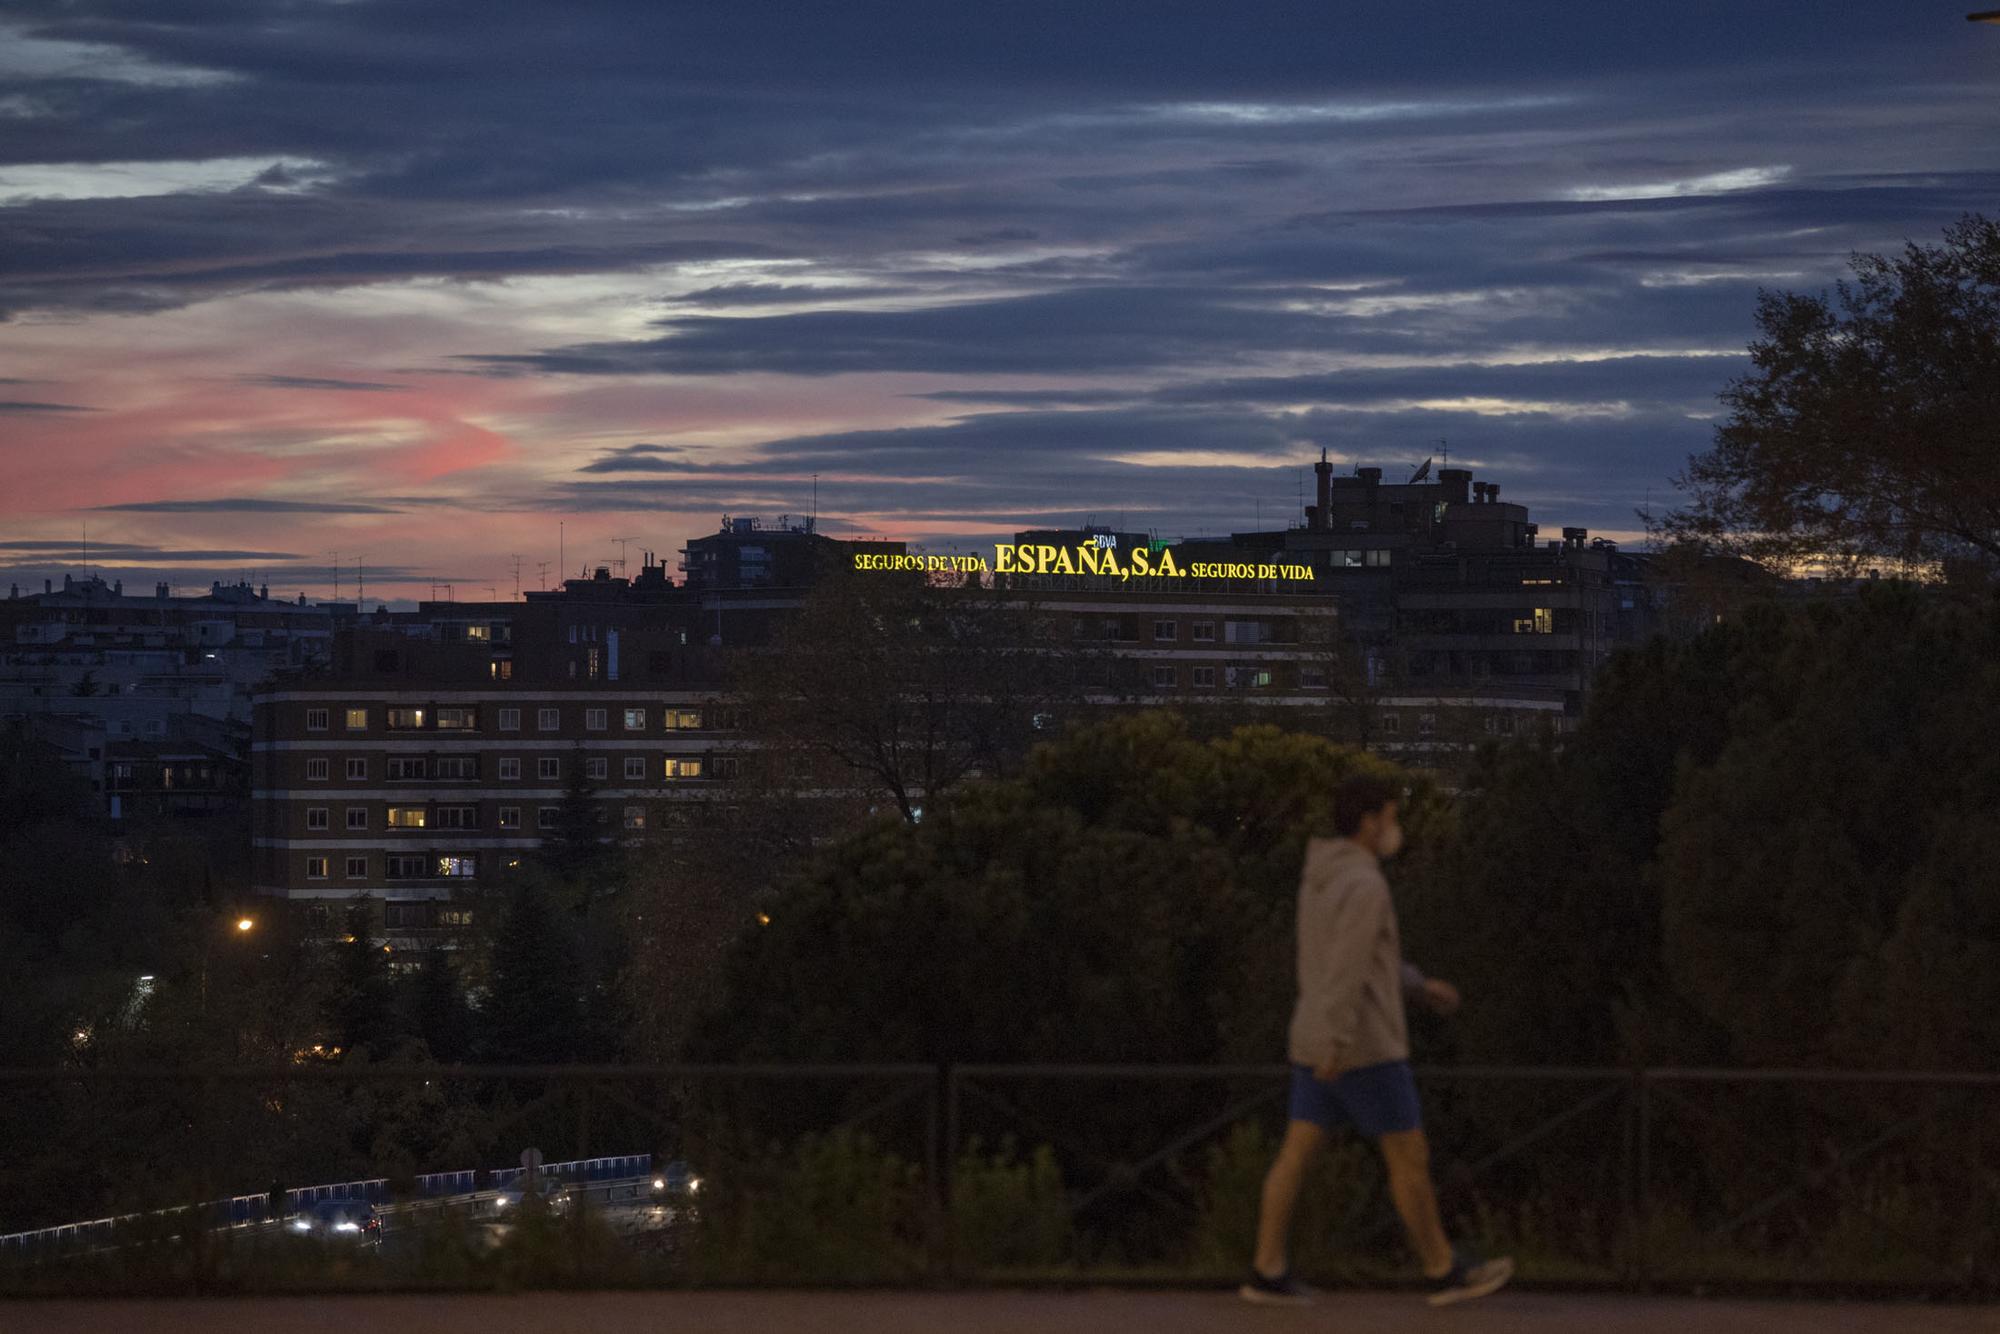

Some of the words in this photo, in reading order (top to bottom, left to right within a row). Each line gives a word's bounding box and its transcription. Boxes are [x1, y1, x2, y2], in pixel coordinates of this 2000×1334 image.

[855, 554, 925, 571] SEGUROS
[927, 555, 948, 572] DE
[950, 556, 988, 573] VIDA
[1191, 562, 1255, 579] SEGUROS
[1258, 564, 1278, 579] DE
[1279, 564, 1315, 580] VIDA
